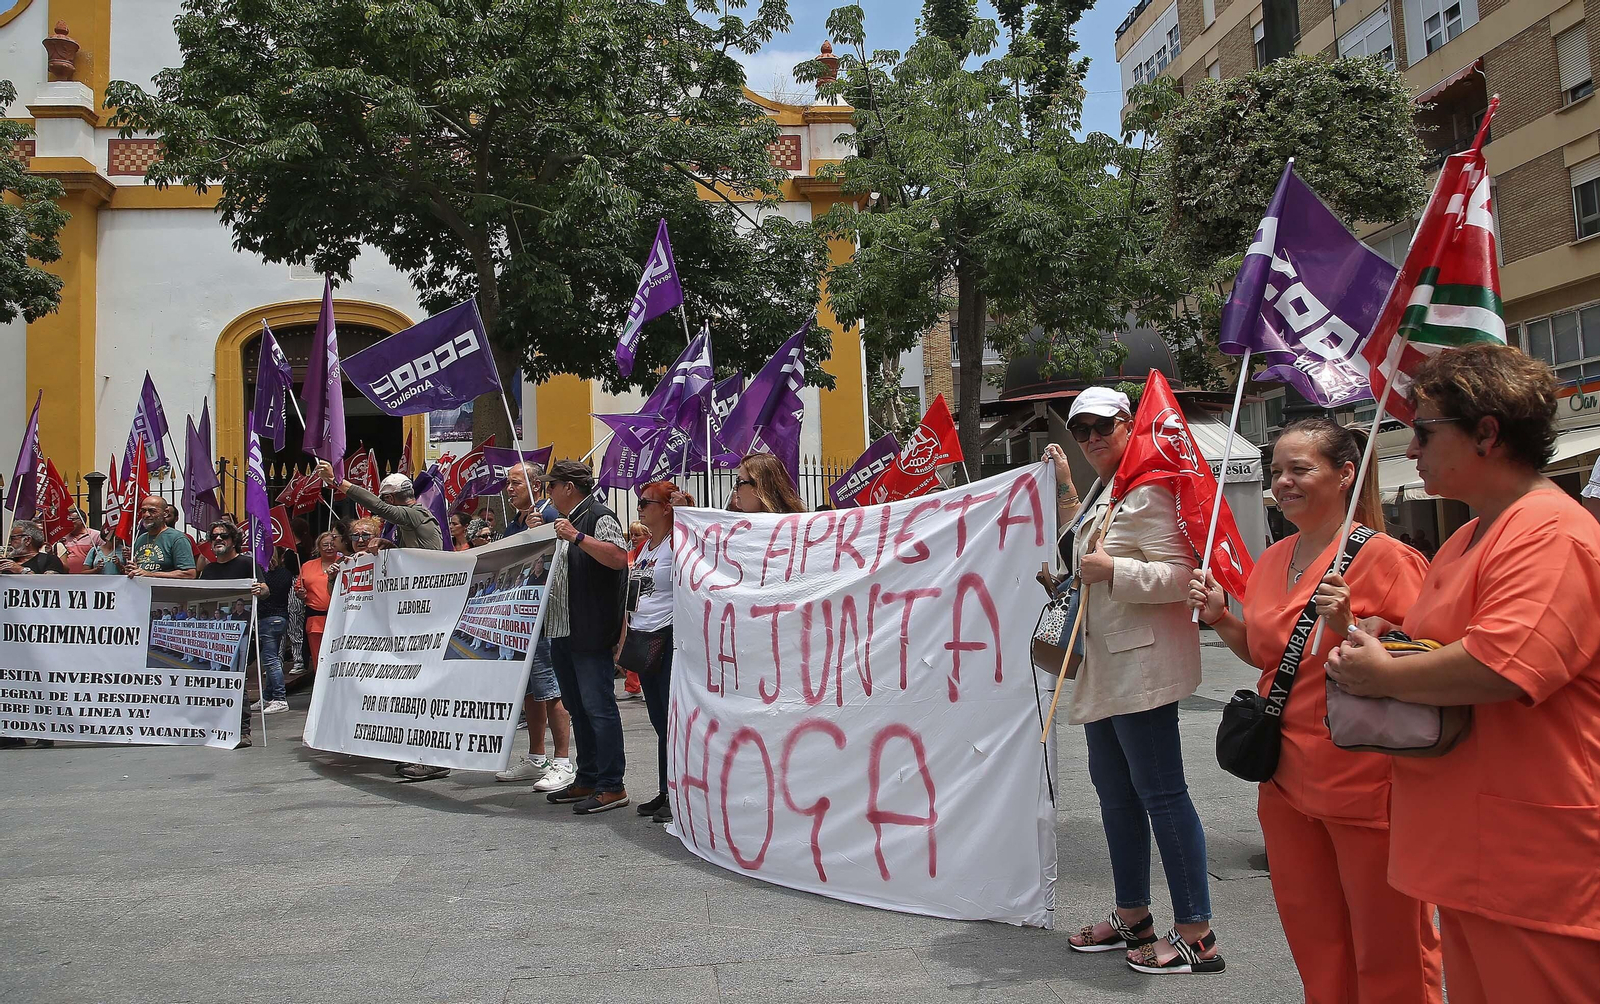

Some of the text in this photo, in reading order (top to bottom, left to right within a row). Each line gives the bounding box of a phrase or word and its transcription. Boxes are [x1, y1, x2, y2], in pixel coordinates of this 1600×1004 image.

[1209, 462, 1252, 478] gesia
[760, 472, 1044, 586] APRIETA
[400, 576, 410, 591] LA
[412, 572, 468, 590] PRECARIEDAD
[4, 588, 116, 610] ¡BASTA YA DE
[516, 589, 540, 600] LINEA
[396, 600, 432, 615] LABORAL
[2, 623, 141, 646] DISCRIMINACION!
[344, 636, 394, 652] RECUPERACION
[394, 636, 406, 653] DEL
[406, 633, 433, 652] TIEMPO
[432, 632, 445, 650] DE
[702, 572, 1002, 707] LA JUNTA
[1279, 612, 1316, 676] BIMBAY
[0, 669, 242, 690] ESITA INVERSIONES Y EMPLEO
[48, 692, 68, 702] DE
[74, 692, 92, 702] LA
[96, 692, 180, 705] RESIDENCIA
[184, 696, 234, 708] TIEMPO
[362, 694, 376, 712] POR
[378, 696, 390, 712] UN
[390, 696, 427, 720] TRABAJO
[430, 698, 450, 720] QUE
[34, 704, 52, 715] DE
[56, 706, 74, 716] LA
[78, 707, 122, 718] LINEA
[128, 708, 150, 718] YA!
[2, 720, 46, 732] TODAS
[50, 722, 75, 734] LAS
[79, 724, 134, 736] PLAZAS
[139, 726, 206, 738] VACANTES
[354, 724, 504, 754] ESTABILIDAD LABORAL Y FAM
